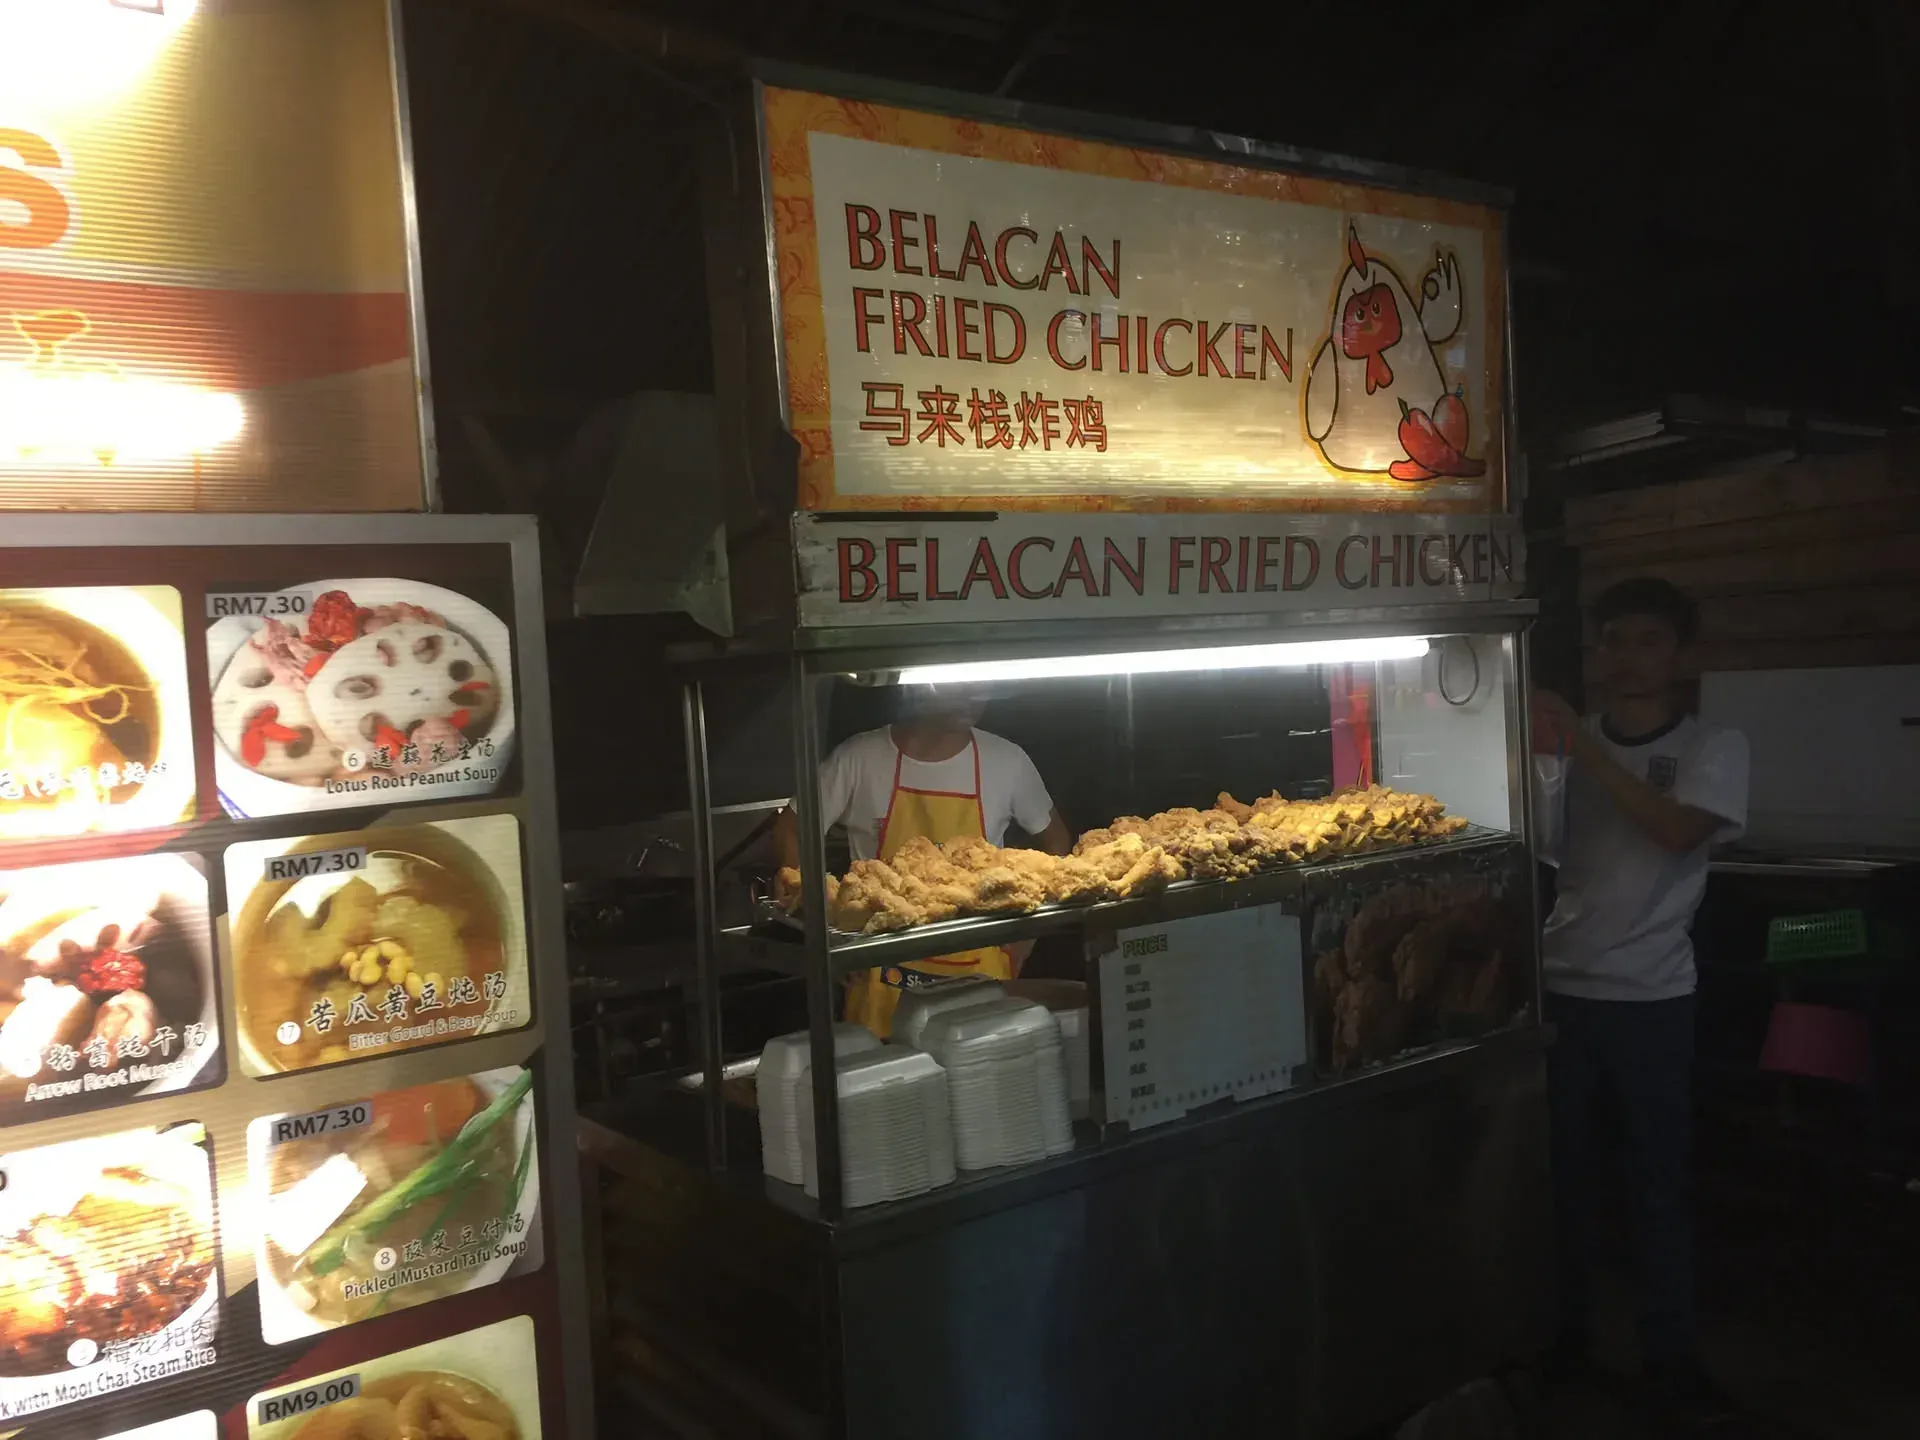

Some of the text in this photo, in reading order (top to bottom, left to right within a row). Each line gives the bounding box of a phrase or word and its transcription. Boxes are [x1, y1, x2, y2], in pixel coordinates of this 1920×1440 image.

[845, 202, 1121, 299] BELACAN
[852, 286, 1294, 383] FRIED CHICKEN
[859, 381, 1108, 453] 马来栈炸鸡
[837, 533, 1514, 604] BELACAN FRIED CHICKEN
[213, 596, 305, 615] RM7.30
[326, 766, 498, 794] Lotus Root Peanut Soup
[347, 752, 358, 767] 6
[271, 852, 360, 880] RM7.30
[1122, 934, 1169, 958] PRICE
[304, 971, 508, 1035] 苦瓜黄豆炖汤
[349, 1008, 518, 1050] Bitter Gourd & Bean Soup
[25, 1079, 82, 1103] Arrow
[84, 1068, 129, 1092] Root
[277, 1106, 366, 1141] RM7.30
[344, 1239, 527, 1299] Pickled Mustard Tafu Soup
[379, 1250, 392, 1266] 8
[14, 1390, 51, 1414] with
[133, 1357, 181, 1382] Steam
[184, 1347, 217, 1369] Rice
[265, 1379, 354, 1421] RM9.00
